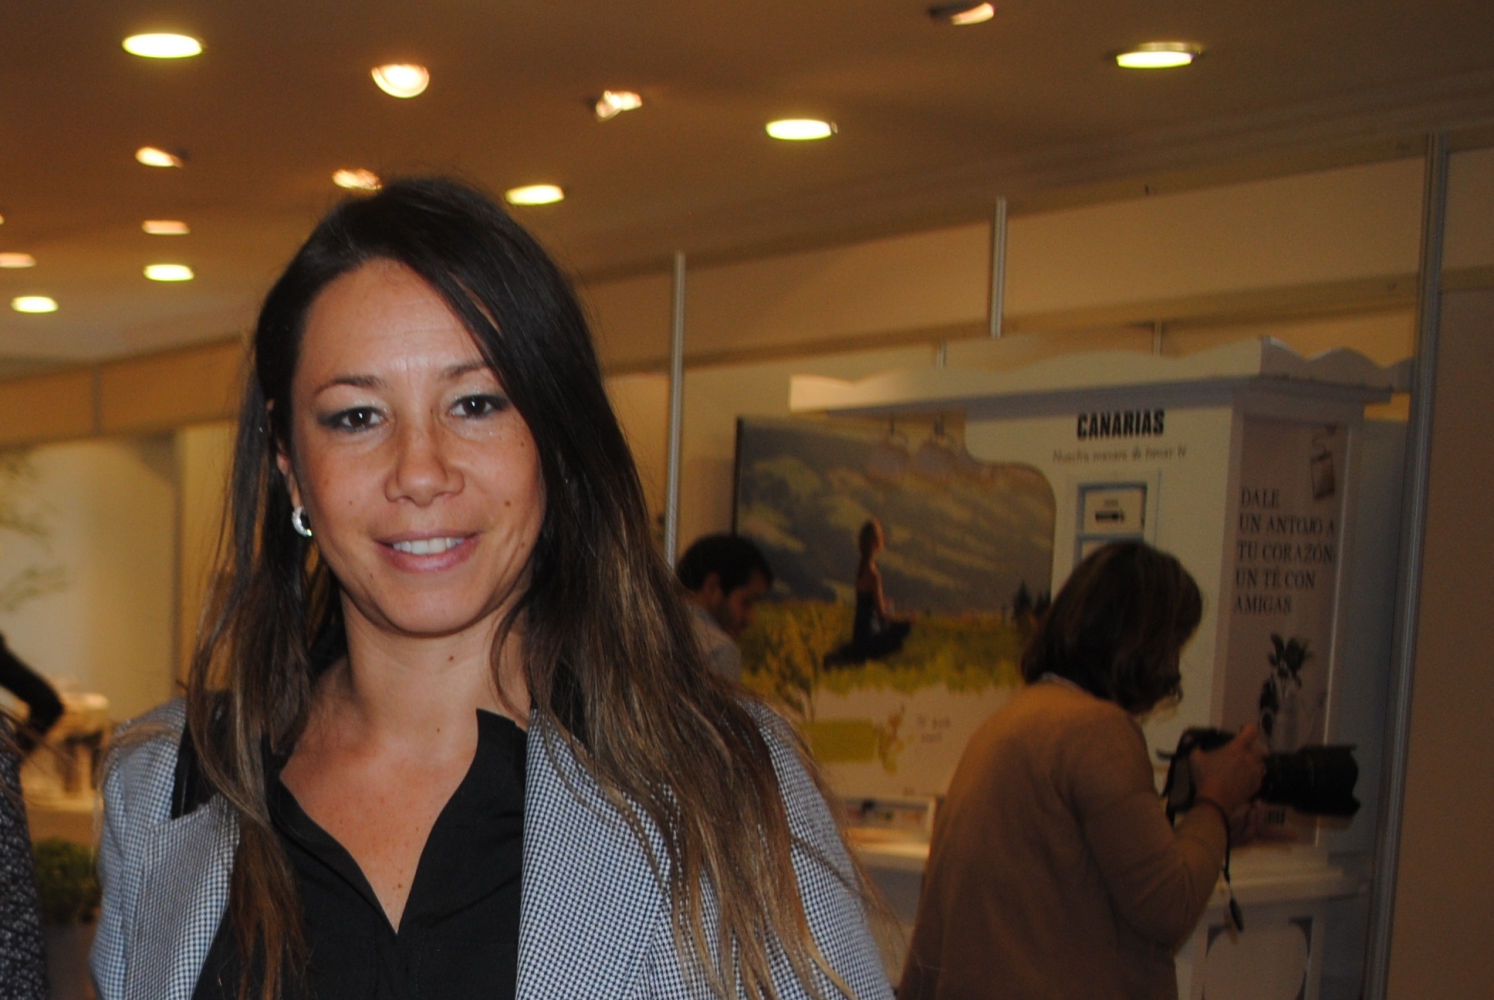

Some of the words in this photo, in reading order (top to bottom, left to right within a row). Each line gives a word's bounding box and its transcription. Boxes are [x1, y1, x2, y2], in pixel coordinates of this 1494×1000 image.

[1077, 408, 1165, 440] CANARIAS
[1241, 486, 1280, 510] DALE
[1238, 512, 1261, 535] UN
[1266, 514, 1324, 536] ANTOJO
[1326, 516, 1336, 536] A
[1237, 539, 1258, 563] TU
[1235, 567, 1258, 590] UN
[1284, 569, 1316, 592] CON
[1233, 593, 1292, 616] AMIGAS
